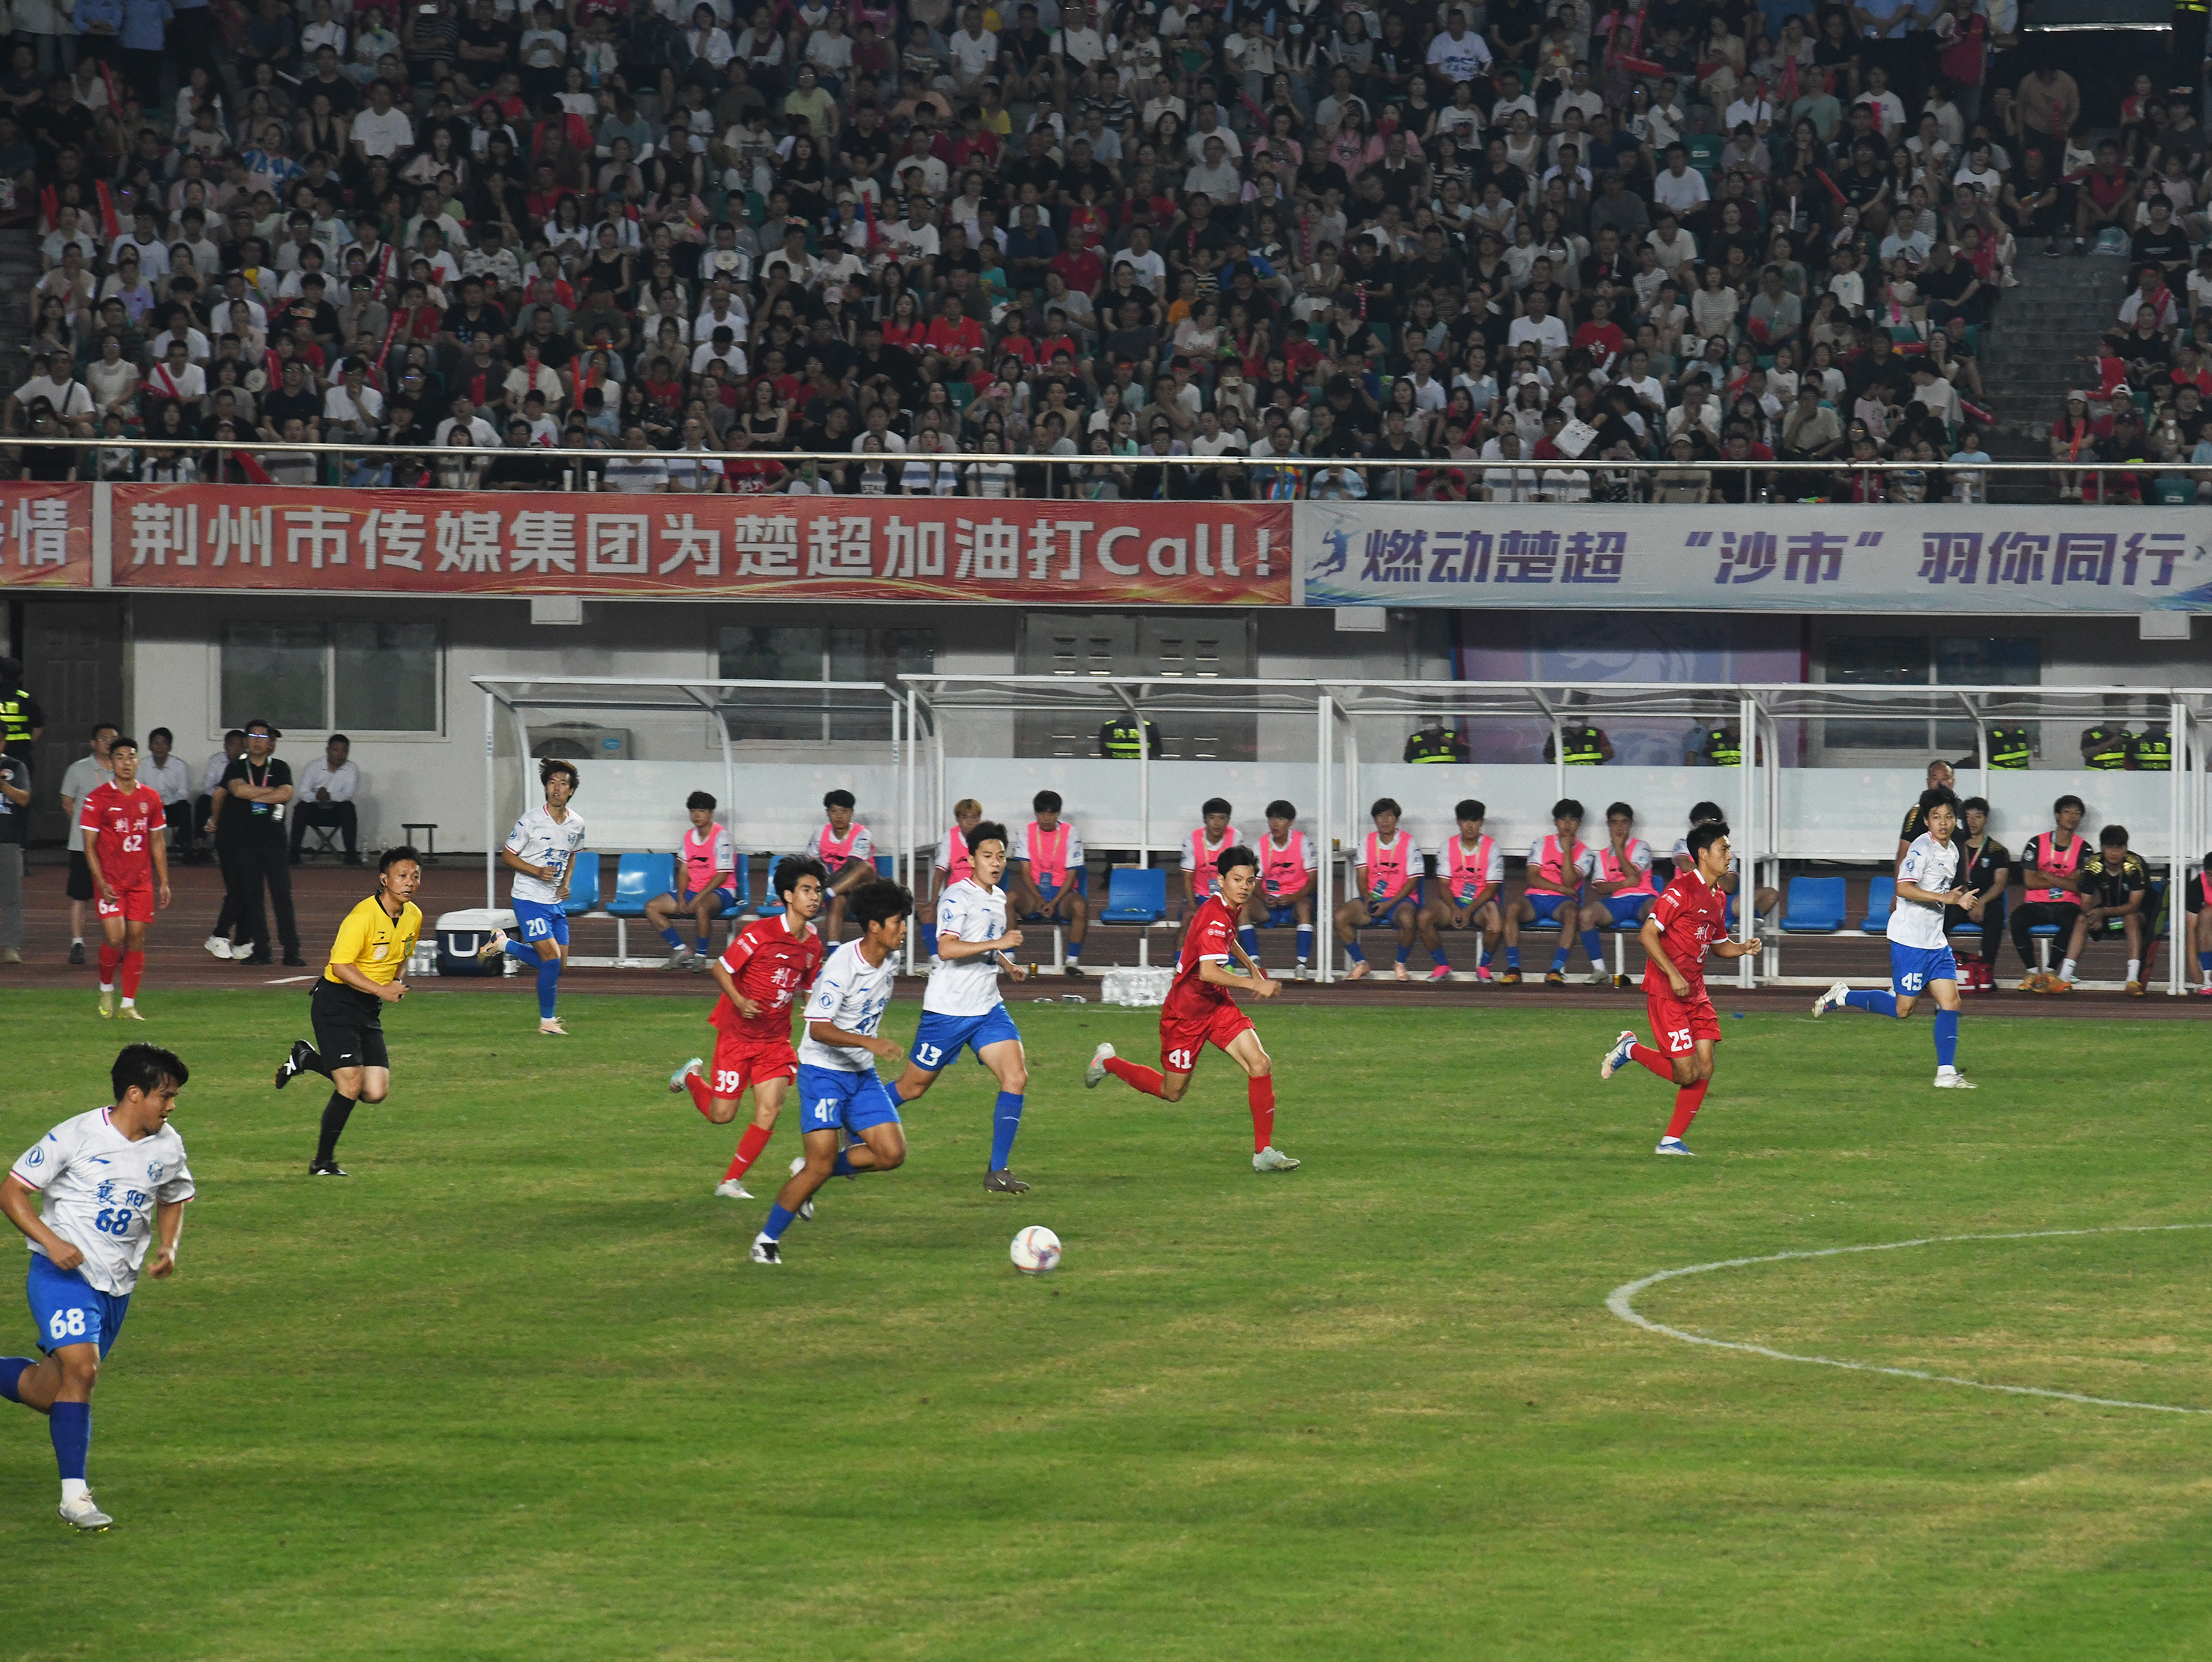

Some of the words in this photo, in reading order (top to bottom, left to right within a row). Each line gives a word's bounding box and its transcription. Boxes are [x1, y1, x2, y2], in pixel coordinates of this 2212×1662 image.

[0, 497, 67, 565] 情
[130, 503, 1270, 580] 荆州市传媒集团为楚超加油打Call!
[1361, 529, 1627, 583] 燃动楚超
[1918, 532, 2186, 585] 羽你同行
[123, 835, 142, 852] 62
[526, 918, 547, 936] 20
[1697, 944, 1709, 963] 2
[1901, 972, 1923, 991] 45
[1667, 1028, 1693, 1052] 25
[916, 1042, 942, 1067] 13
[1169, 1049, 1193, 1070] 41
[715, 1070, 739, 1093] 39
[814, 1098, 838, 1122] 47
[97, 1179, 146, 1207] 襄阳
[95, 1207, 132, 1235] 68
[49, 1308, 86, 1339] 68
